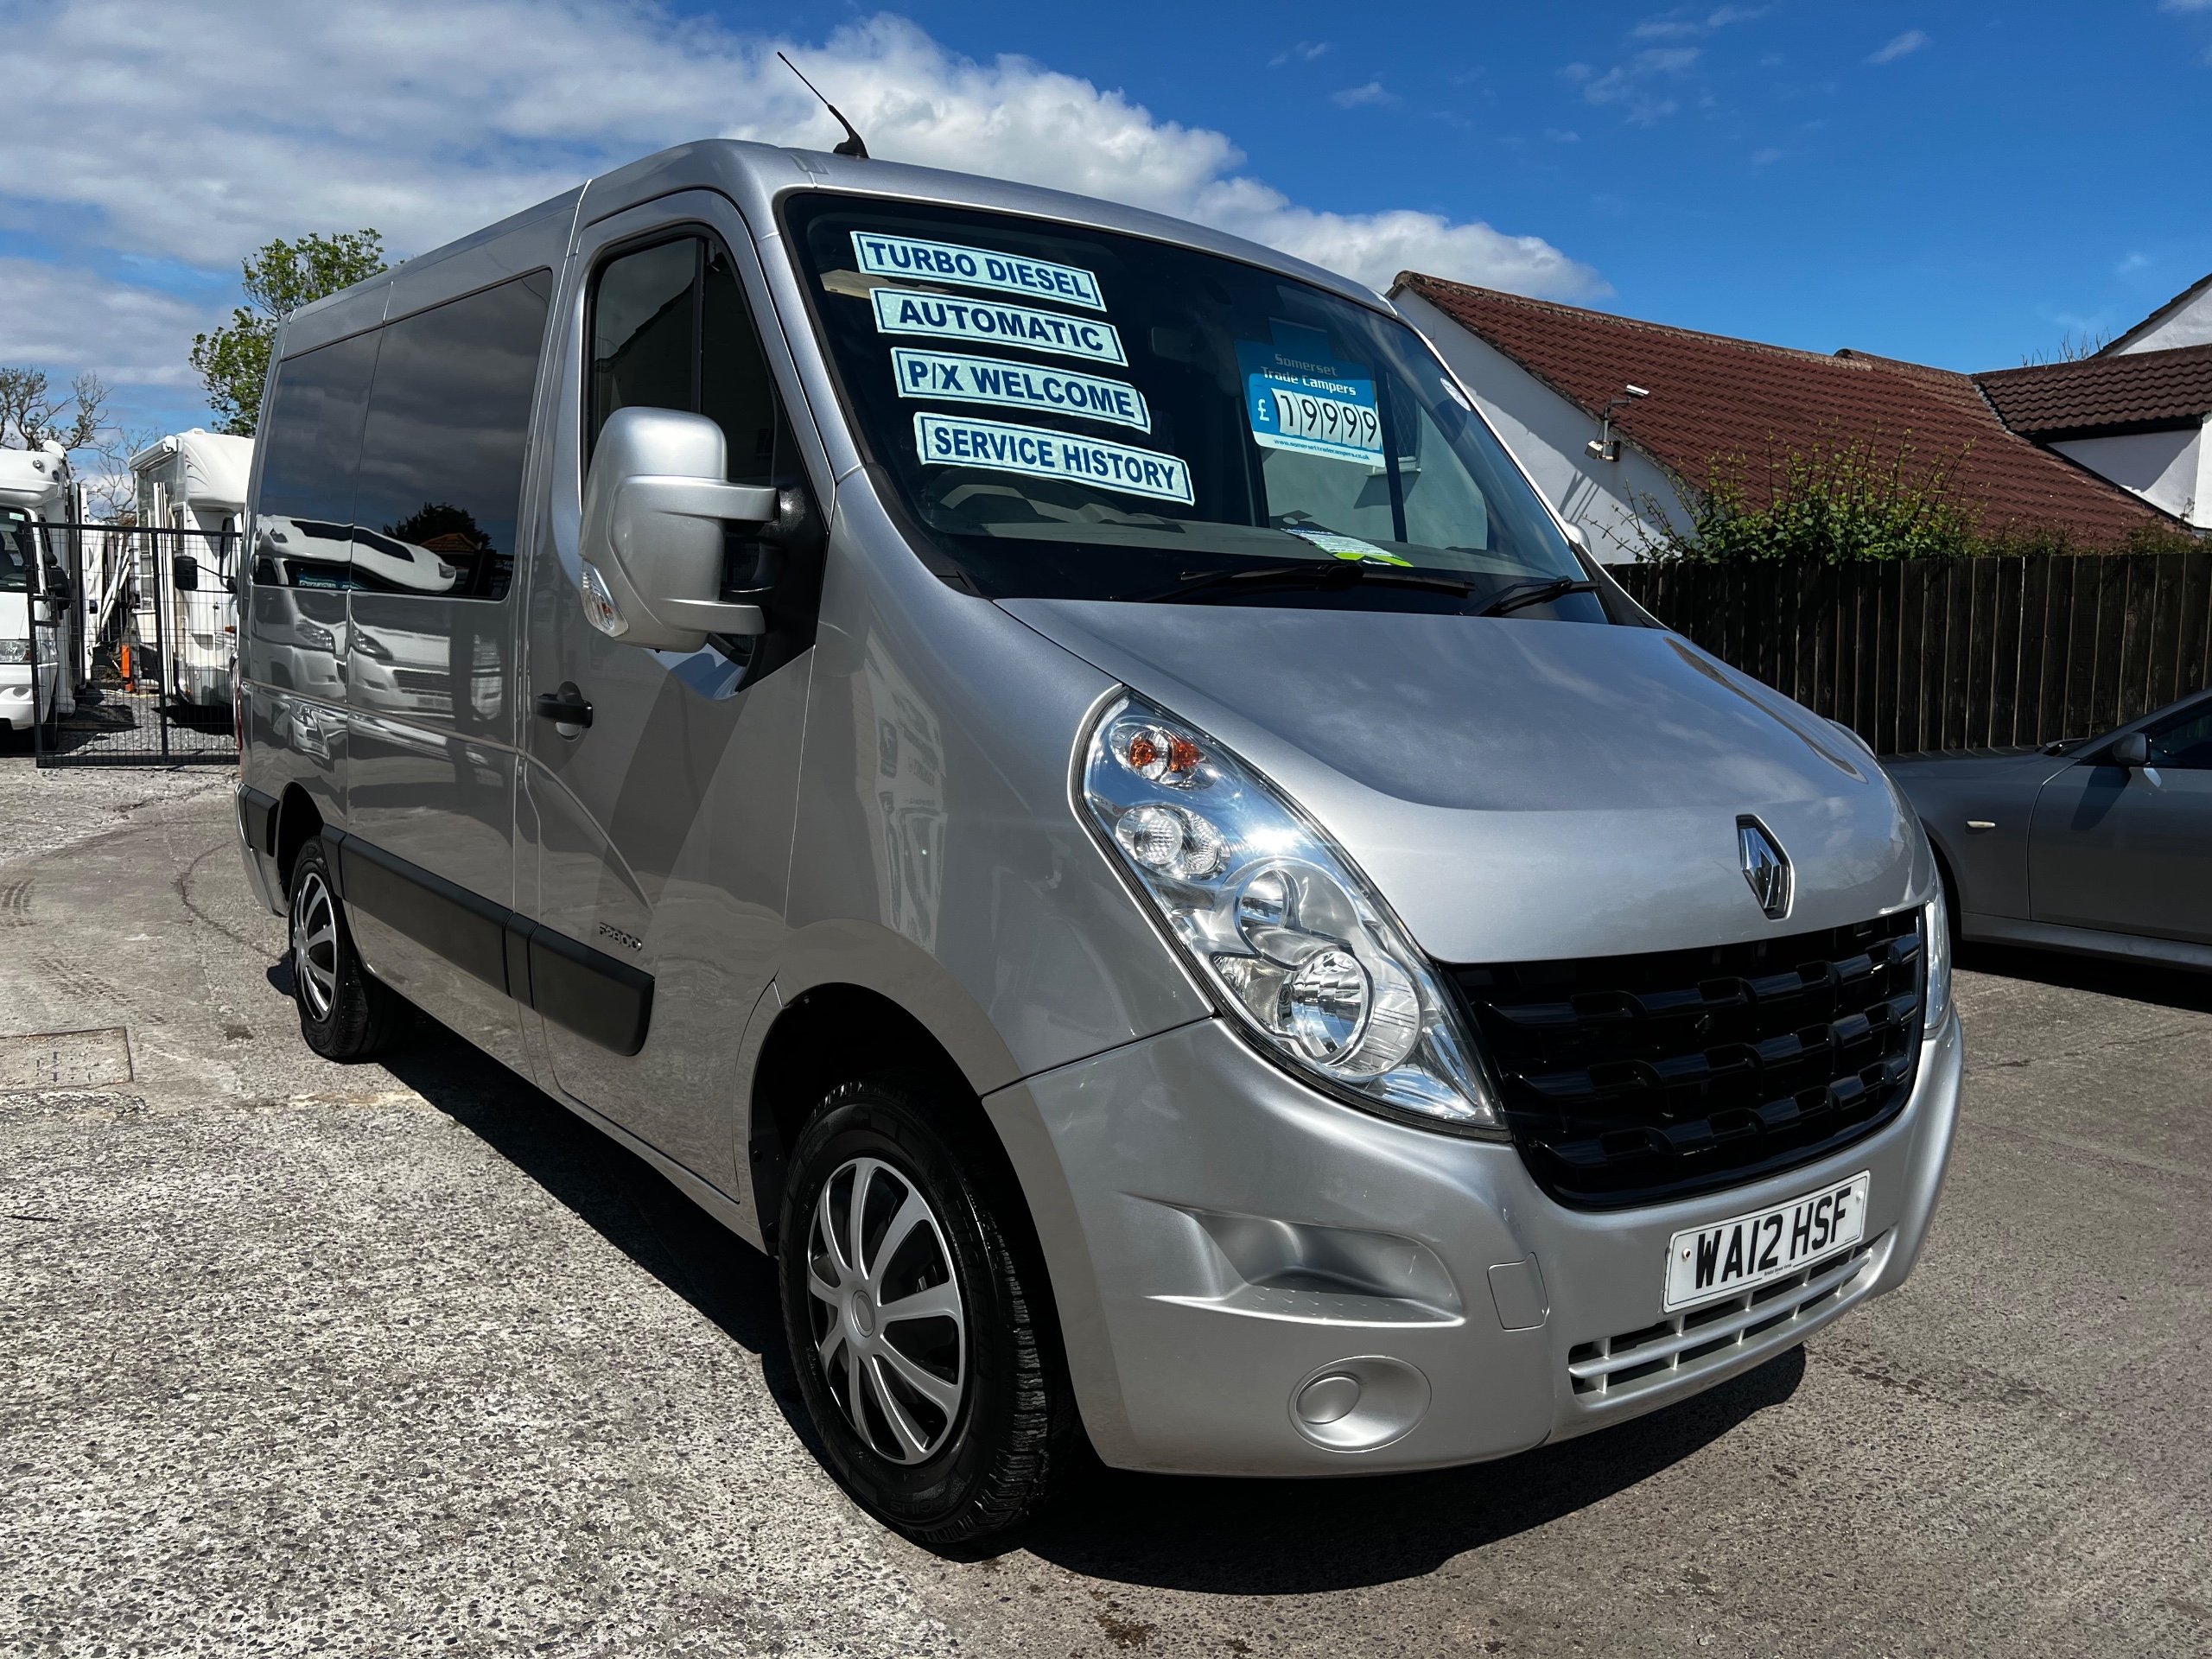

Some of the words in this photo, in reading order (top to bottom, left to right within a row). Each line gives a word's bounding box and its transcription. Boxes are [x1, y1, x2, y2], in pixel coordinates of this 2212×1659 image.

[866, 241, 977, 276] TURBO
[985, 257, 1091, 299] DIESEL
[899, 300, 1103, 351] AUTOMATIC
[908, 361, 964, 391] P/X
[970, 367, 1135, 416] WELCOME
[1261, 366, 1299, 384] Trade
[1302, 375, 1357, 395] Campers
[1274, 353, 1338, 377] Somerset
[935, 427, 1055, 467] SERVICE
[1063, 444, 1175, 490] HISTORY
[1695, 1214, 1783, 1290] WA12
[1789, 1186, 1852, 1261] HSF
